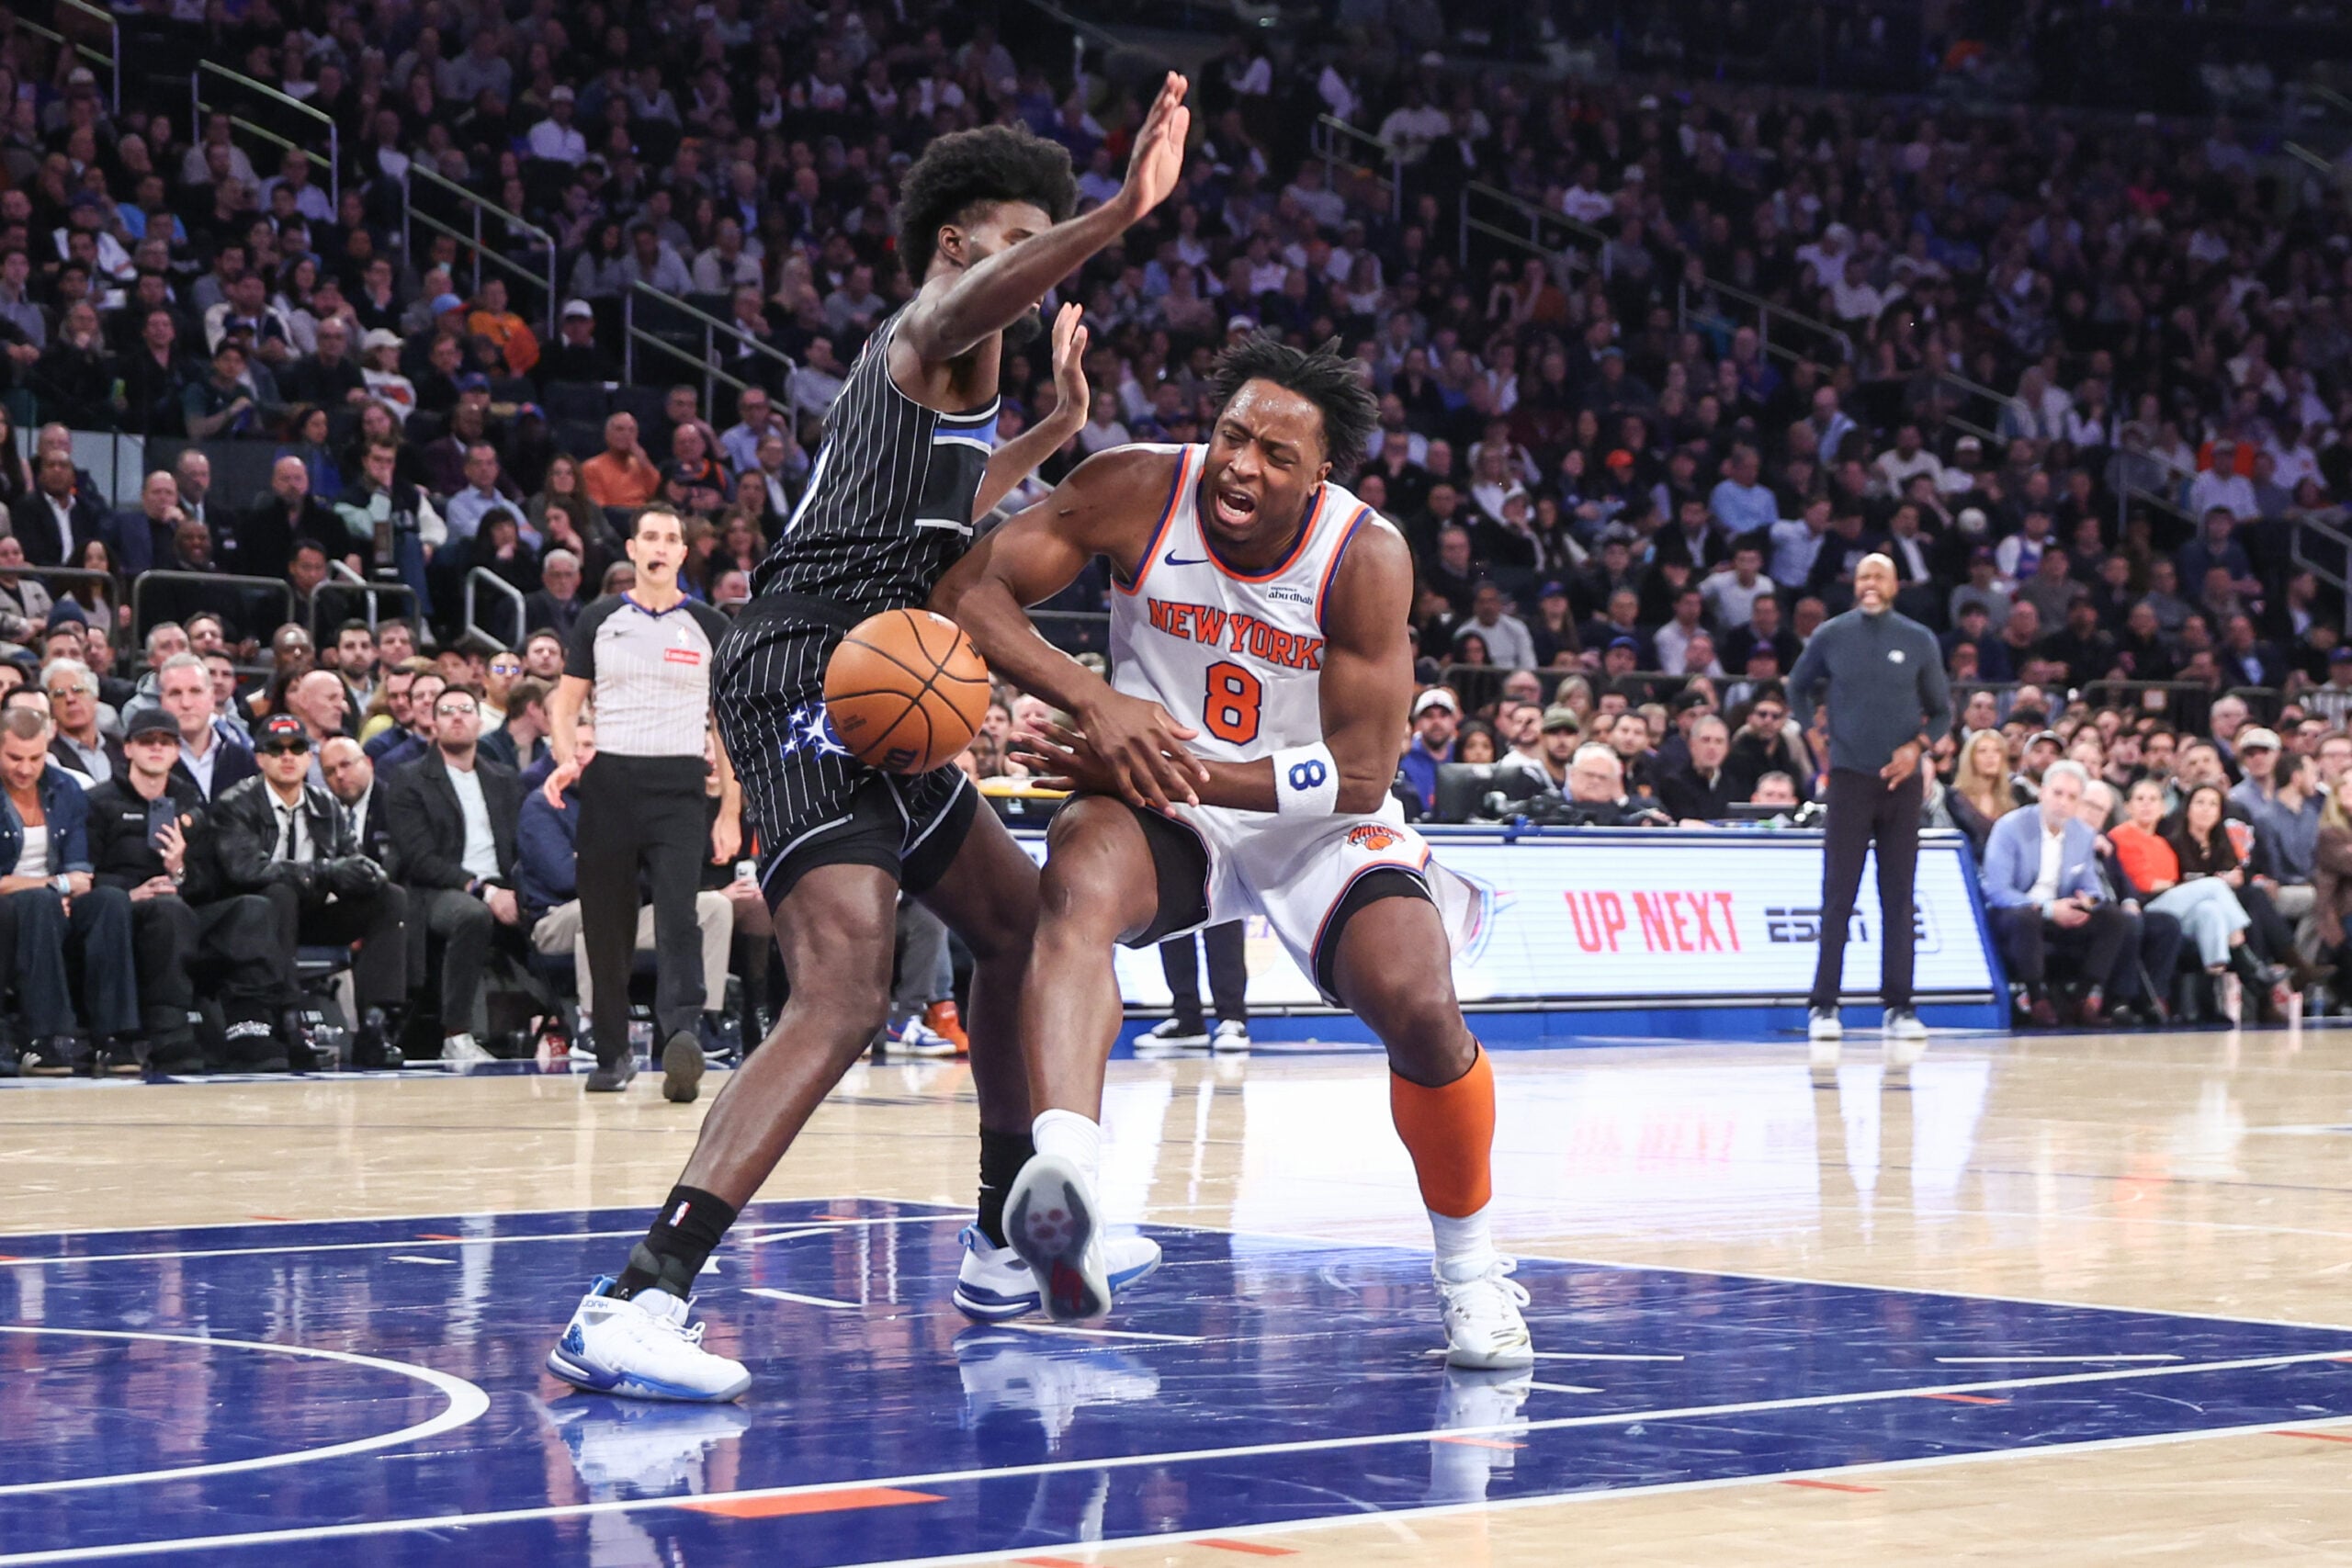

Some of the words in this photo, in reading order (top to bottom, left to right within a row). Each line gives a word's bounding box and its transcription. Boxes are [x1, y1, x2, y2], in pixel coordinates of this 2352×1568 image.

[1268, 591, 1288, 600] abu
[1289, 593, 1313, 605] dhab
[1148, 598, 1227, 646] NEW
[1229, 614, 1324, 670] YORK
[1203, 660, 1262, 746] 8
[1289, 760, 1327, 791] 8
[1565, 892, 1626, 952] UP
[1633, 891, 1741, 952] NEXT
[1765, 908, 1869, 942] ESN
